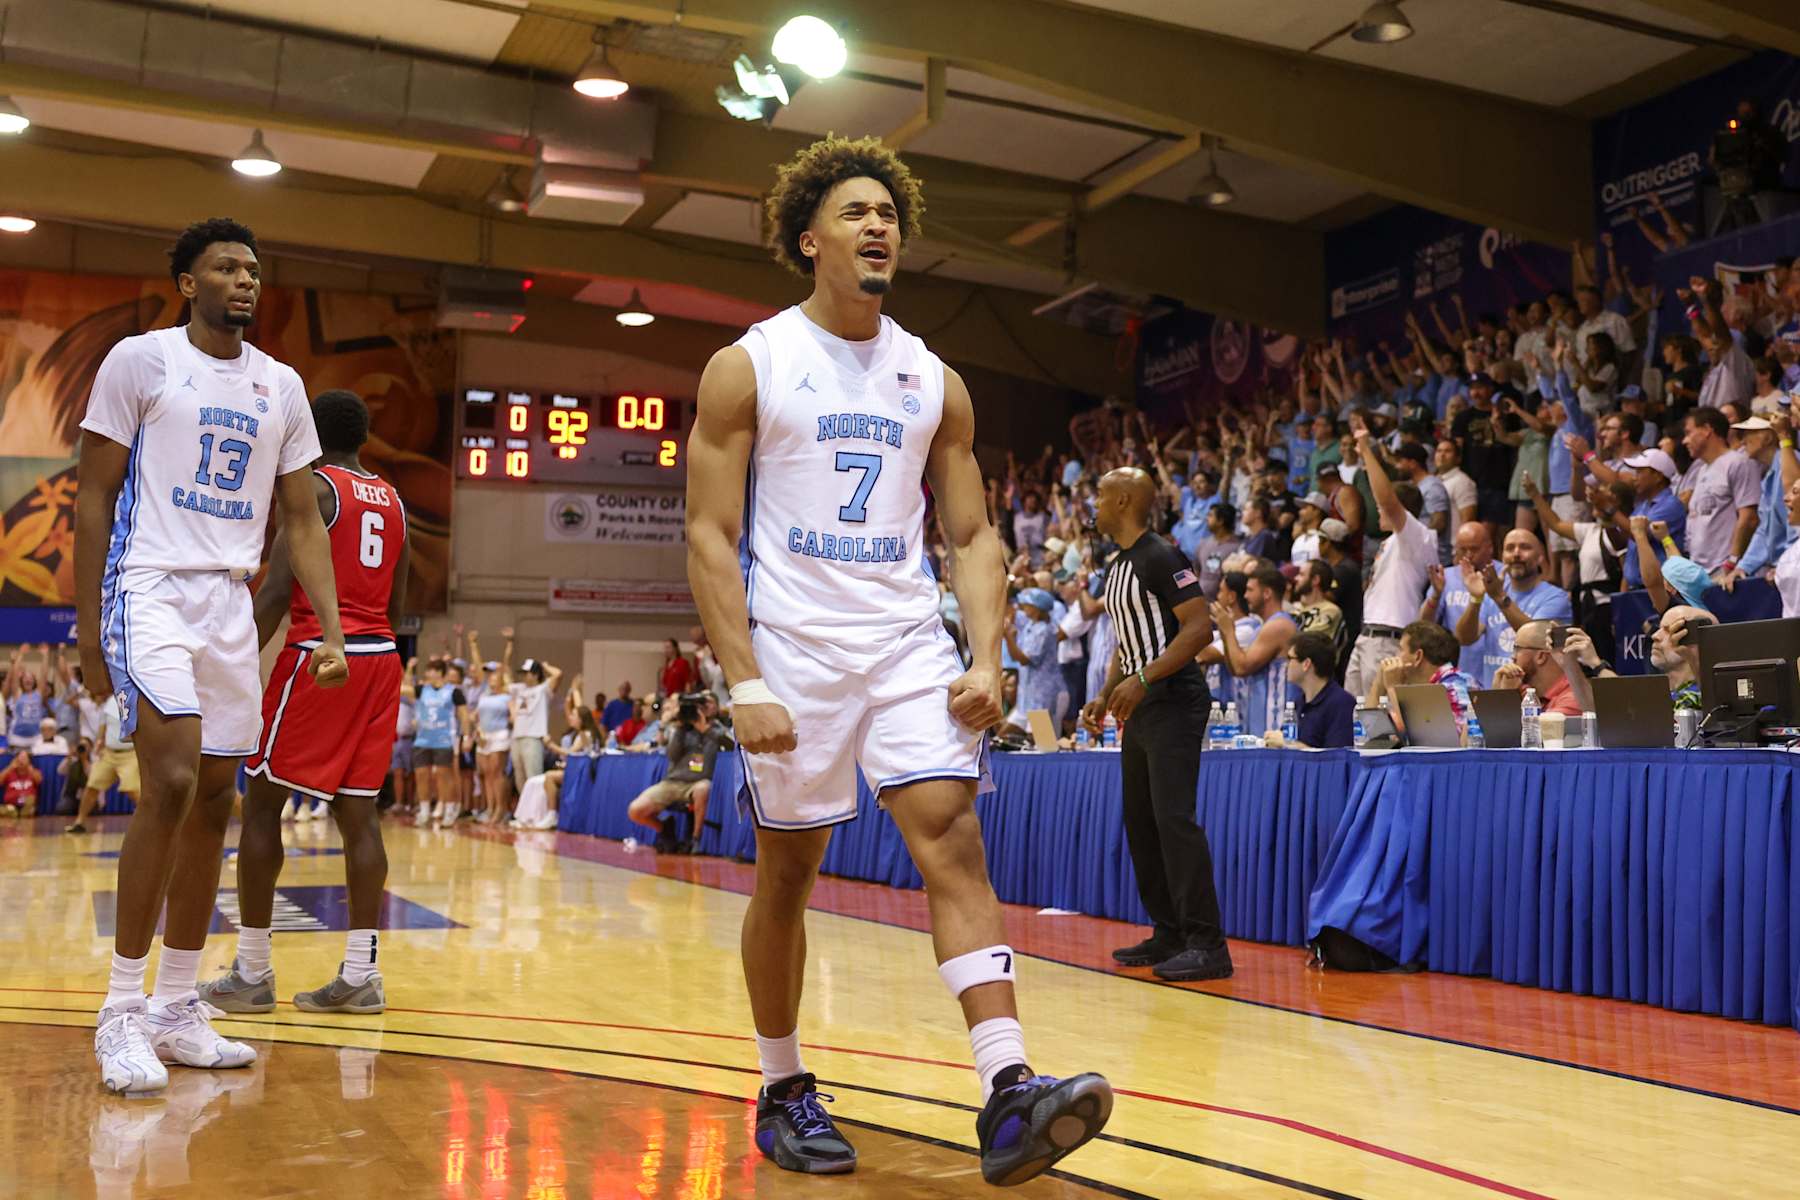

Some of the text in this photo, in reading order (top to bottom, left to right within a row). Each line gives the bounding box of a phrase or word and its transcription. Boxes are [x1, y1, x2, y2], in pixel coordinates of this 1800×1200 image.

[1601, 152, 1701, 204] OUTRIGGER
[199, 407, 259, 438] NORTH
[509, 405, 528, 432] 0
[548, 410, 589, 445] 92
[617, 396, 664, 431] 0.0
[817, 413, 903, 449] NORTH
[195, 433, 252, 492] 13
[469, 449, 487, 476] 0
[660, 440, 677, 466] 2
[172, 486, 253, 520] CAROLINA
[352, 479, 391, 508] CHEEKS
[596, 494, 657, 509] COUNTY
[660, 497, 679, 510] OF
[835, 451, 882, 523] 7
[600, 512, 633, 523] Parks
[360, 510, 384, 568] 6
[788, 526, 907, 563] CAROLINA
[991, 952, 1012, 974] 7
